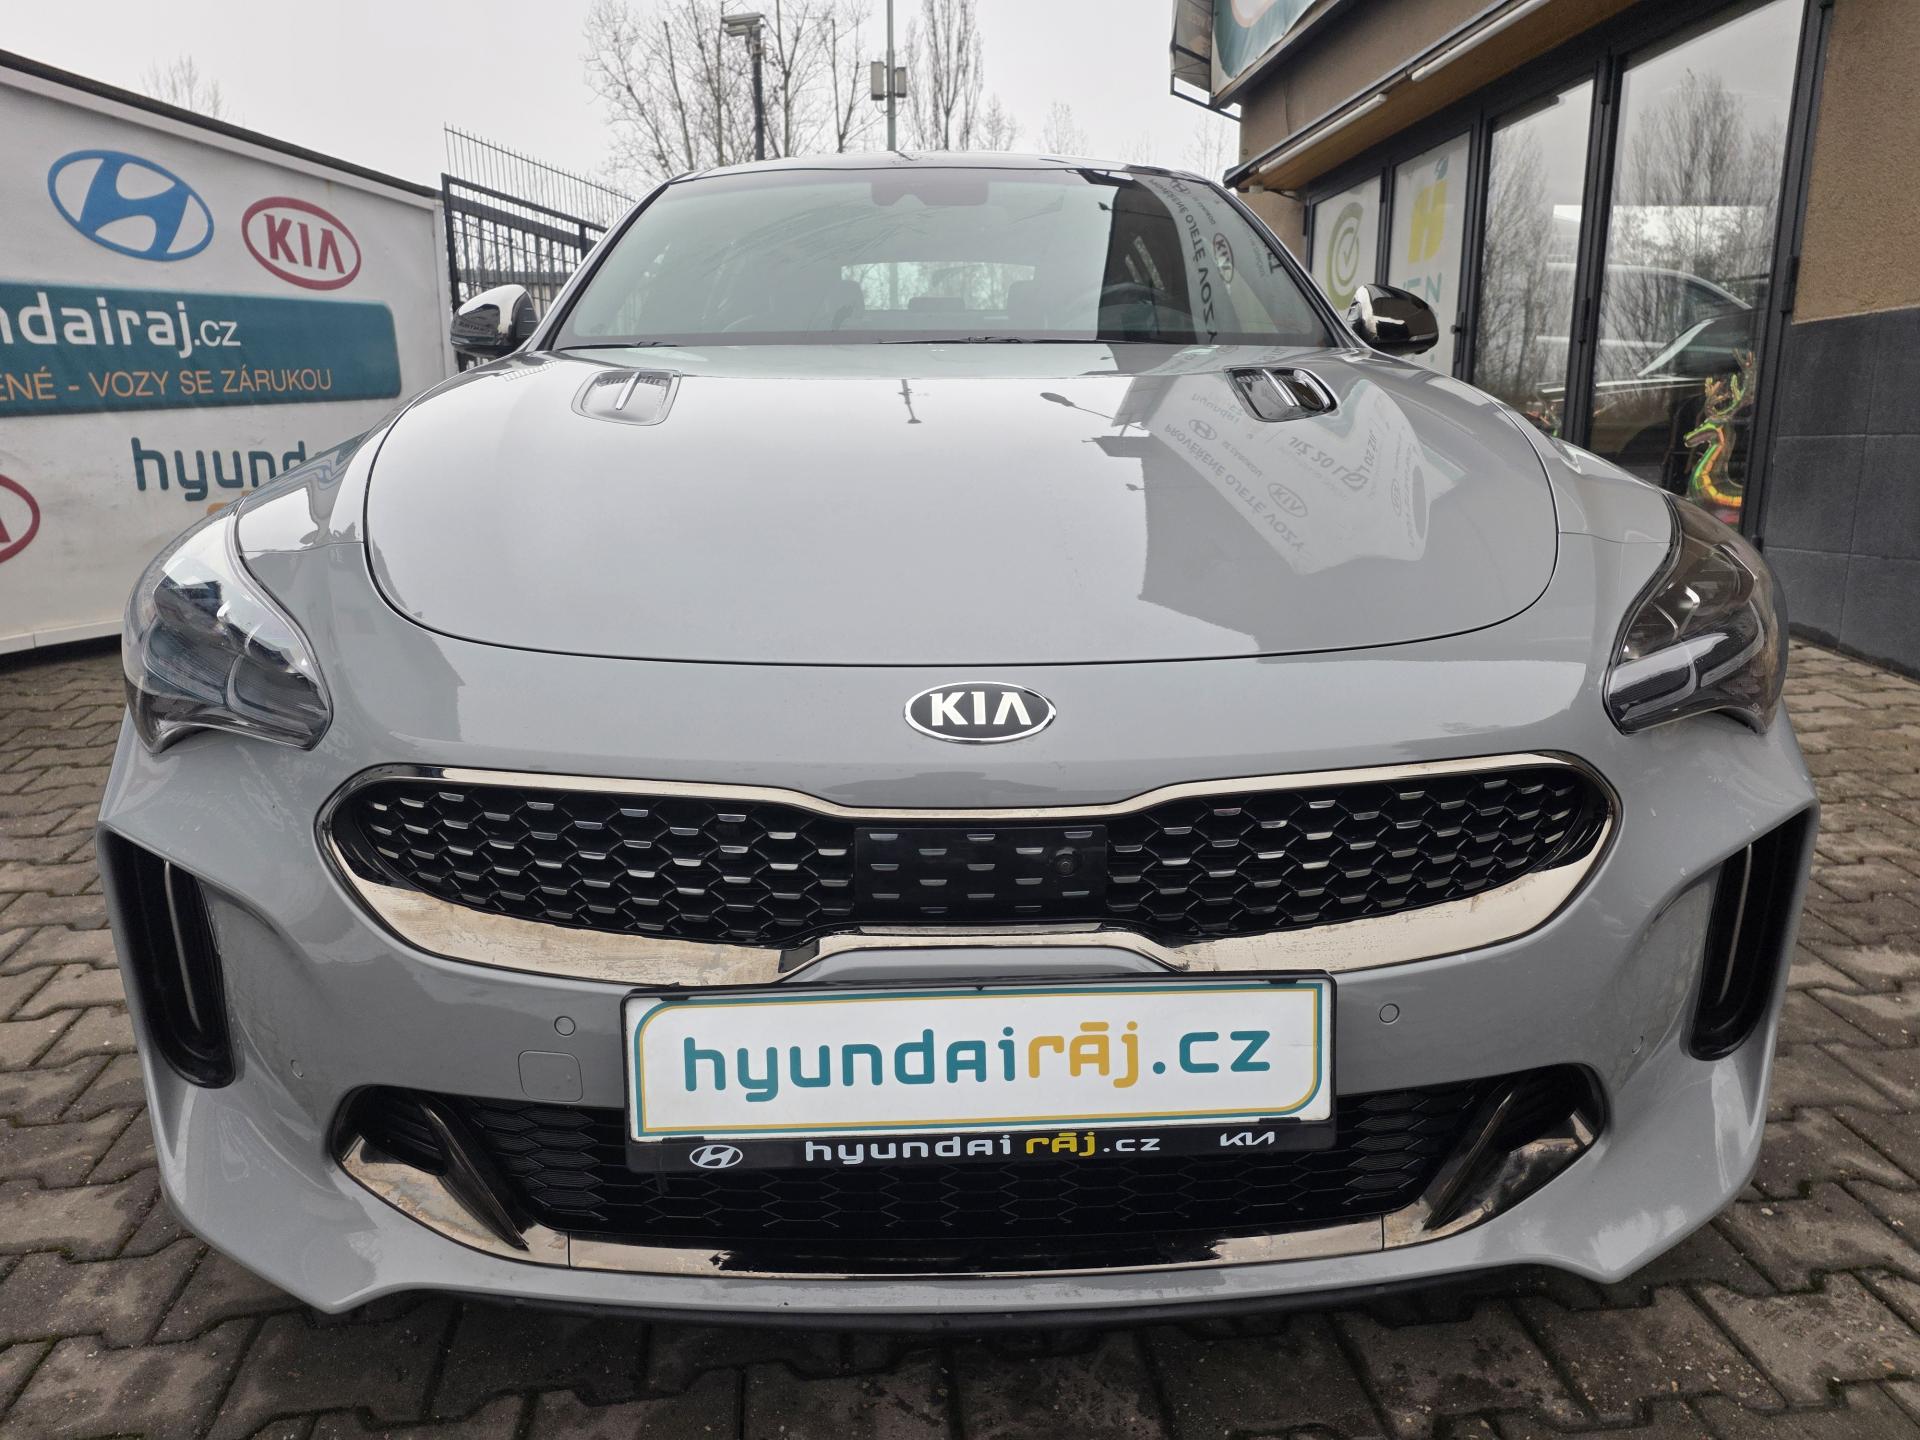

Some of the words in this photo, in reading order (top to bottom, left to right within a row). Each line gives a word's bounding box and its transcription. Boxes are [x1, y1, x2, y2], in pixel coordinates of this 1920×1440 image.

[263, 213, 346, 275] KIA
[88, 369, 169, 398] VOZY
[178, 370, 215, 395] SE
[220, 364, 333, 394] ZÁRUKOU
[929, 691, 1012, 727] KIA
